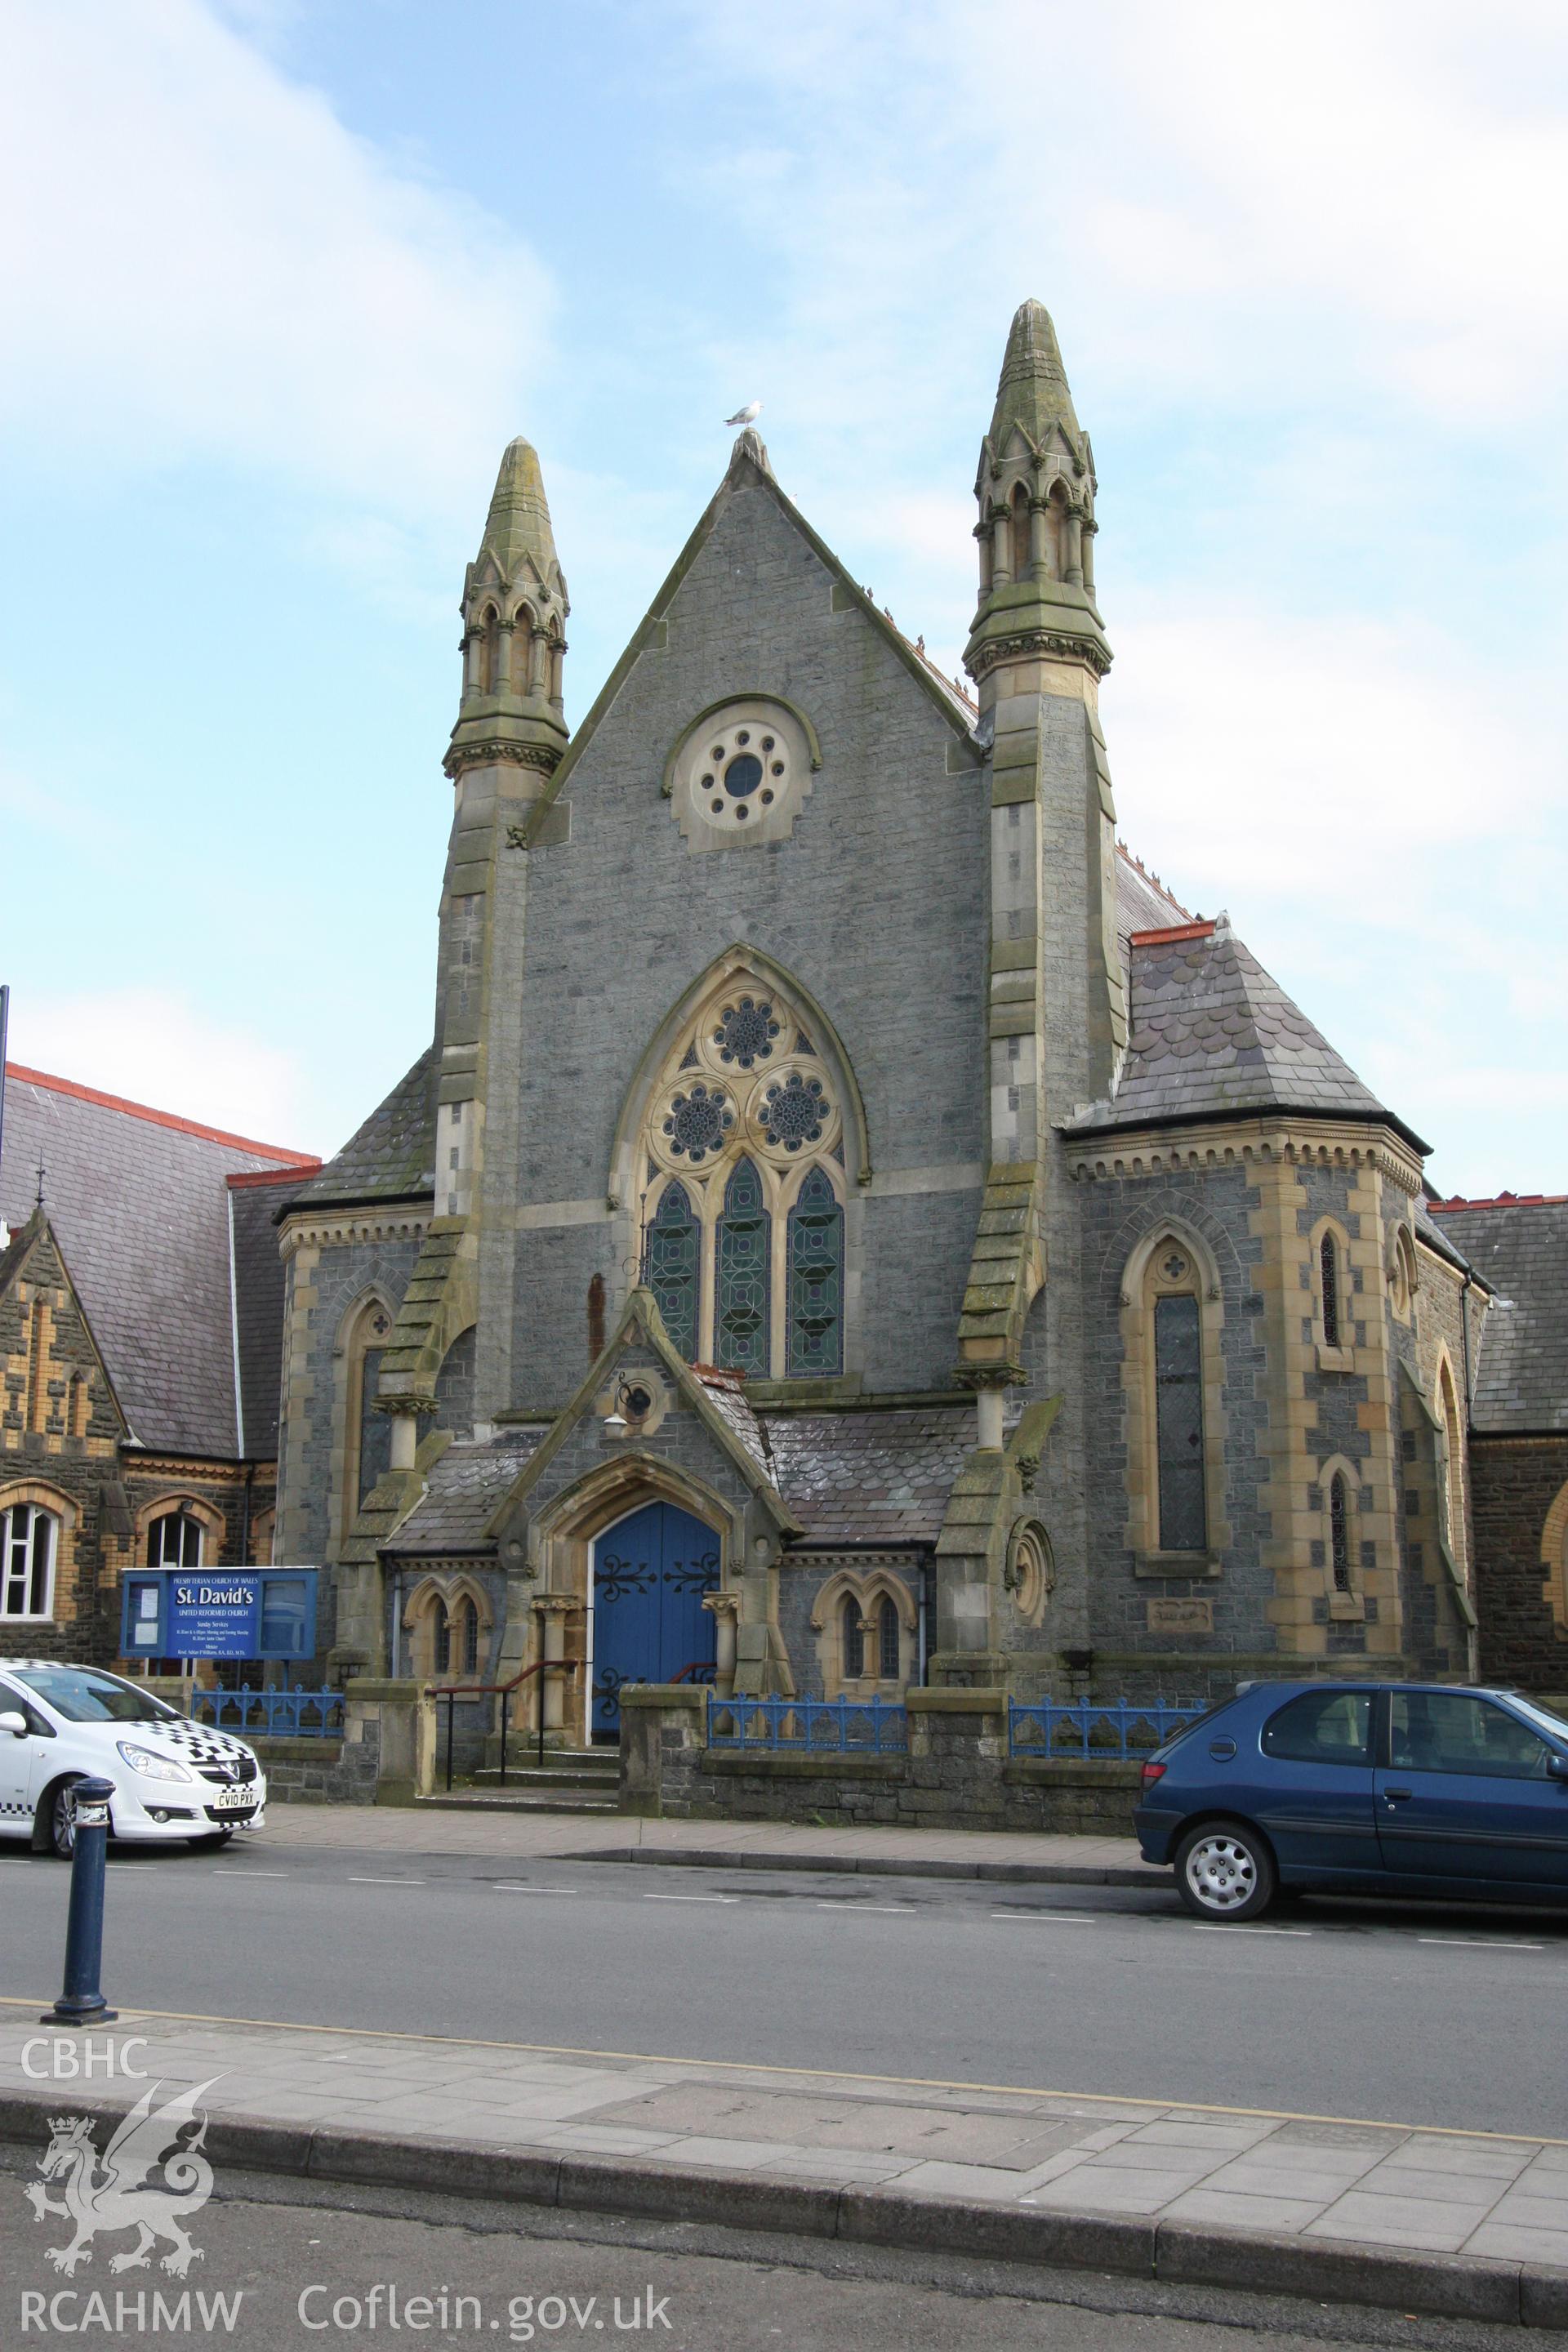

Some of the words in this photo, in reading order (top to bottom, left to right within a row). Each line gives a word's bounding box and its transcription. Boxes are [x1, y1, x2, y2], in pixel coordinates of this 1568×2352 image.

[176, 1587, 196, 1604] St.
[199, 1587, 253, 1604] David's
[227, 1609, 248, 1617] CHURCH
[219, 1794, 238, 1806] CV10
[240, 1793, 254, 1806] PXX
